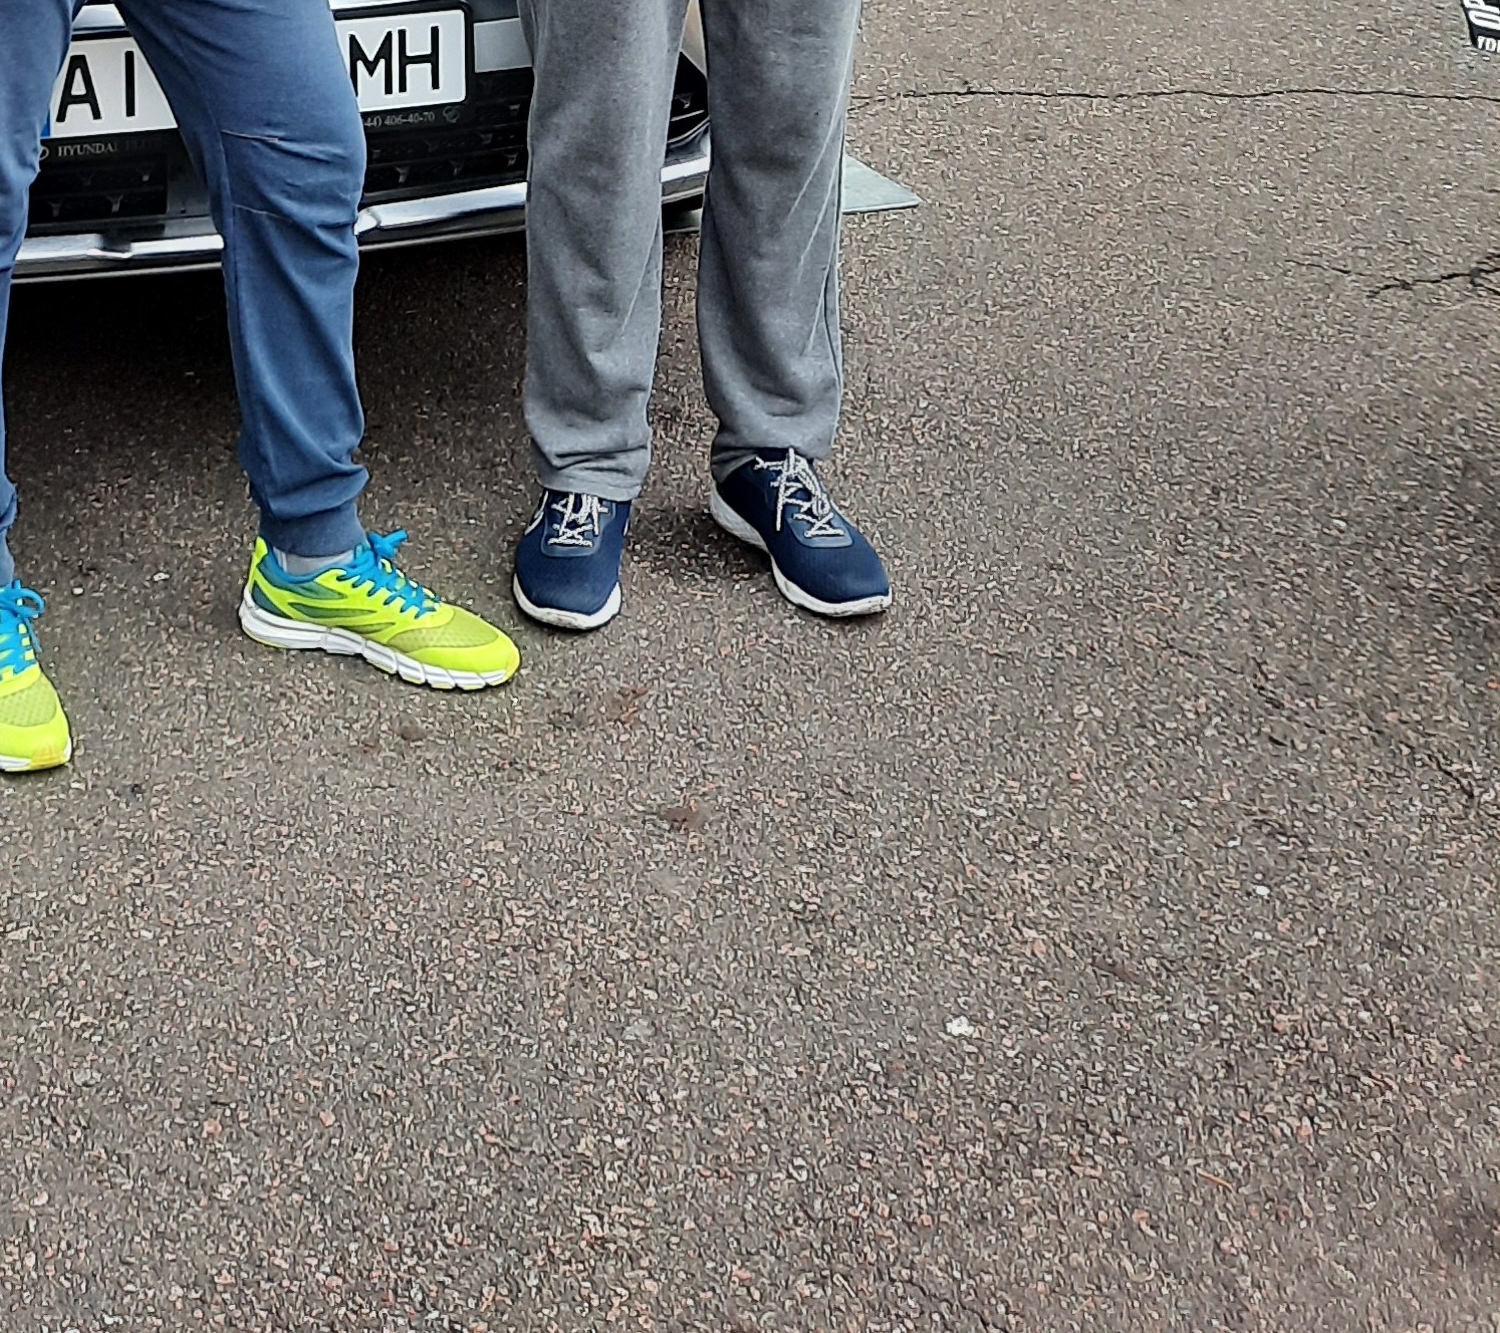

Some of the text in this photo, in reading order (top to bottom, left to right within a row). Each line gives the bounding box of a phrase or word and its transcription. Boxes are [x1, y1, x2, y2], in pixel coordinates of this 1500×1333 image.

[55, 25, 440, 123] AI MH
[364, 116, 382, 127] 44)
